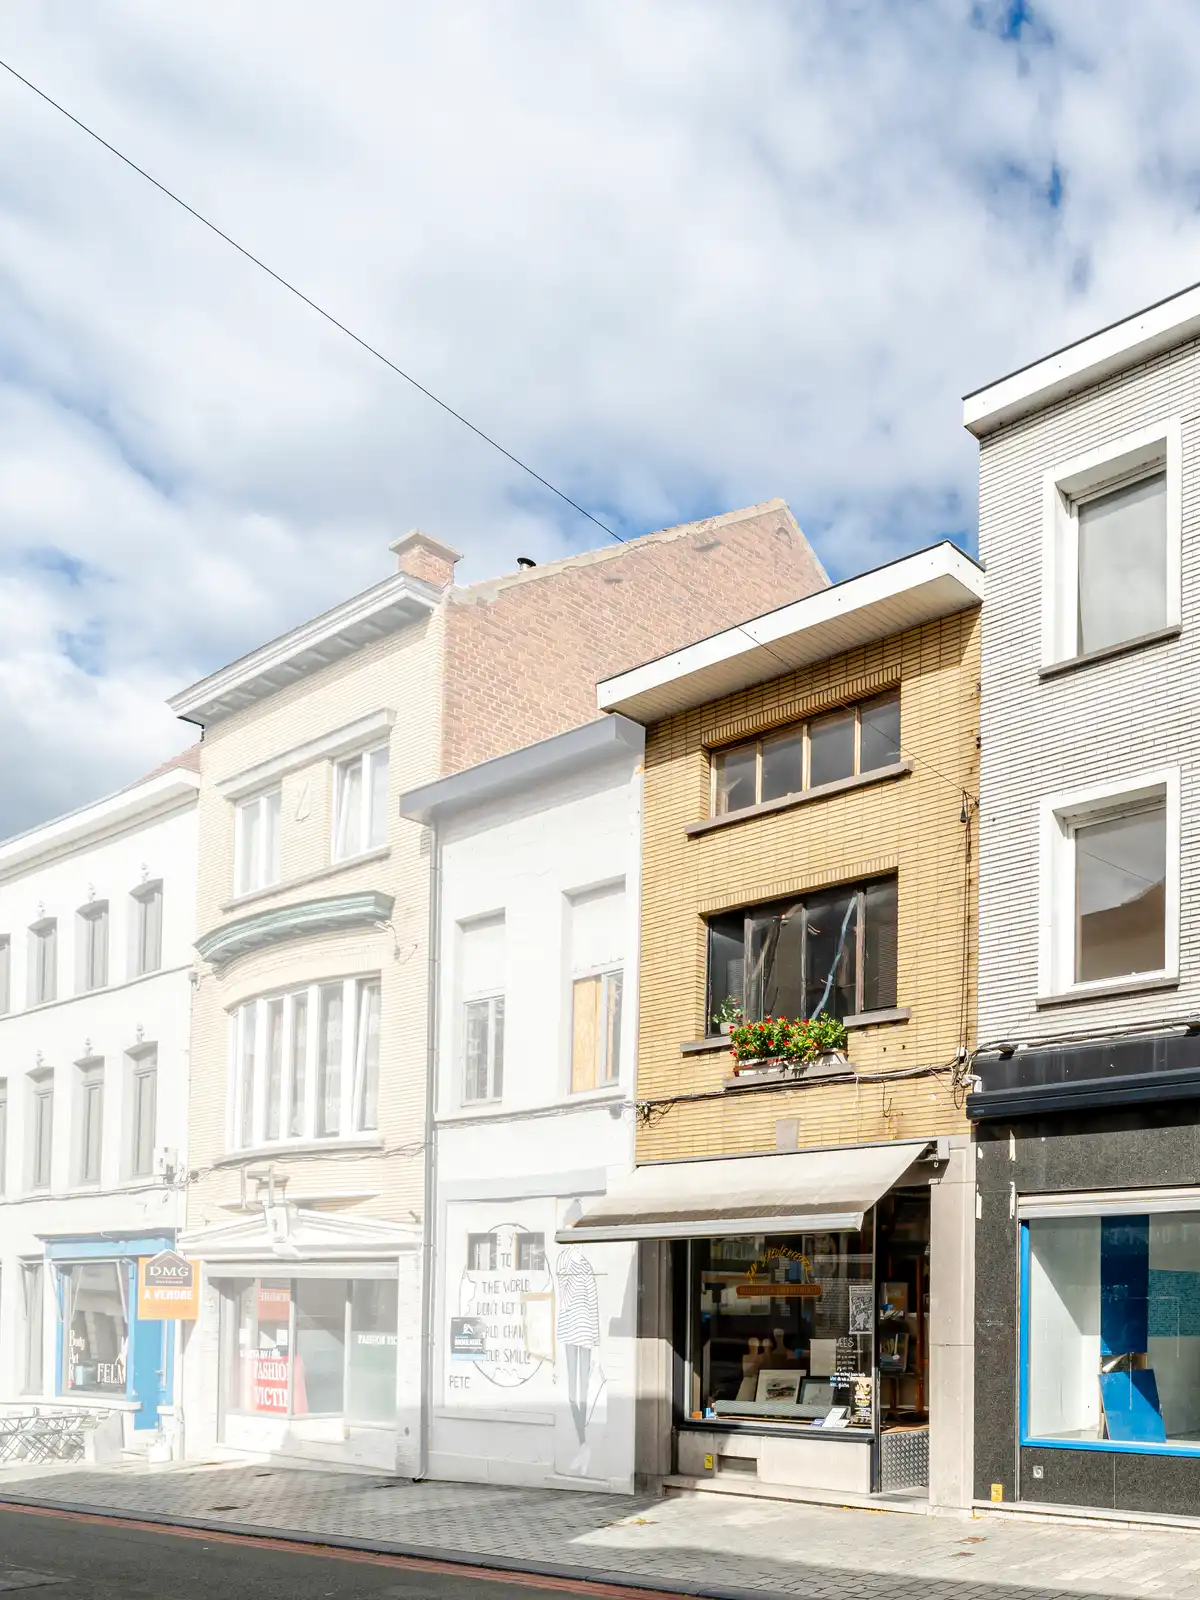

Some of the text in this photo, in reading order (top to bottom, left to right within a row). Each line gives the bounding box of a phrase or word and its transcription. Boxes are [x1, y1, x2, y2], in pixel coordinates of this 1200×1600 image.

[149, 1266, 189, 1277] DMG
[482, 1280, 501, 1294] THE
[154, 1289, 194, 1301] VENDRE
[253, 1361, 289, 1380] FASHIO
